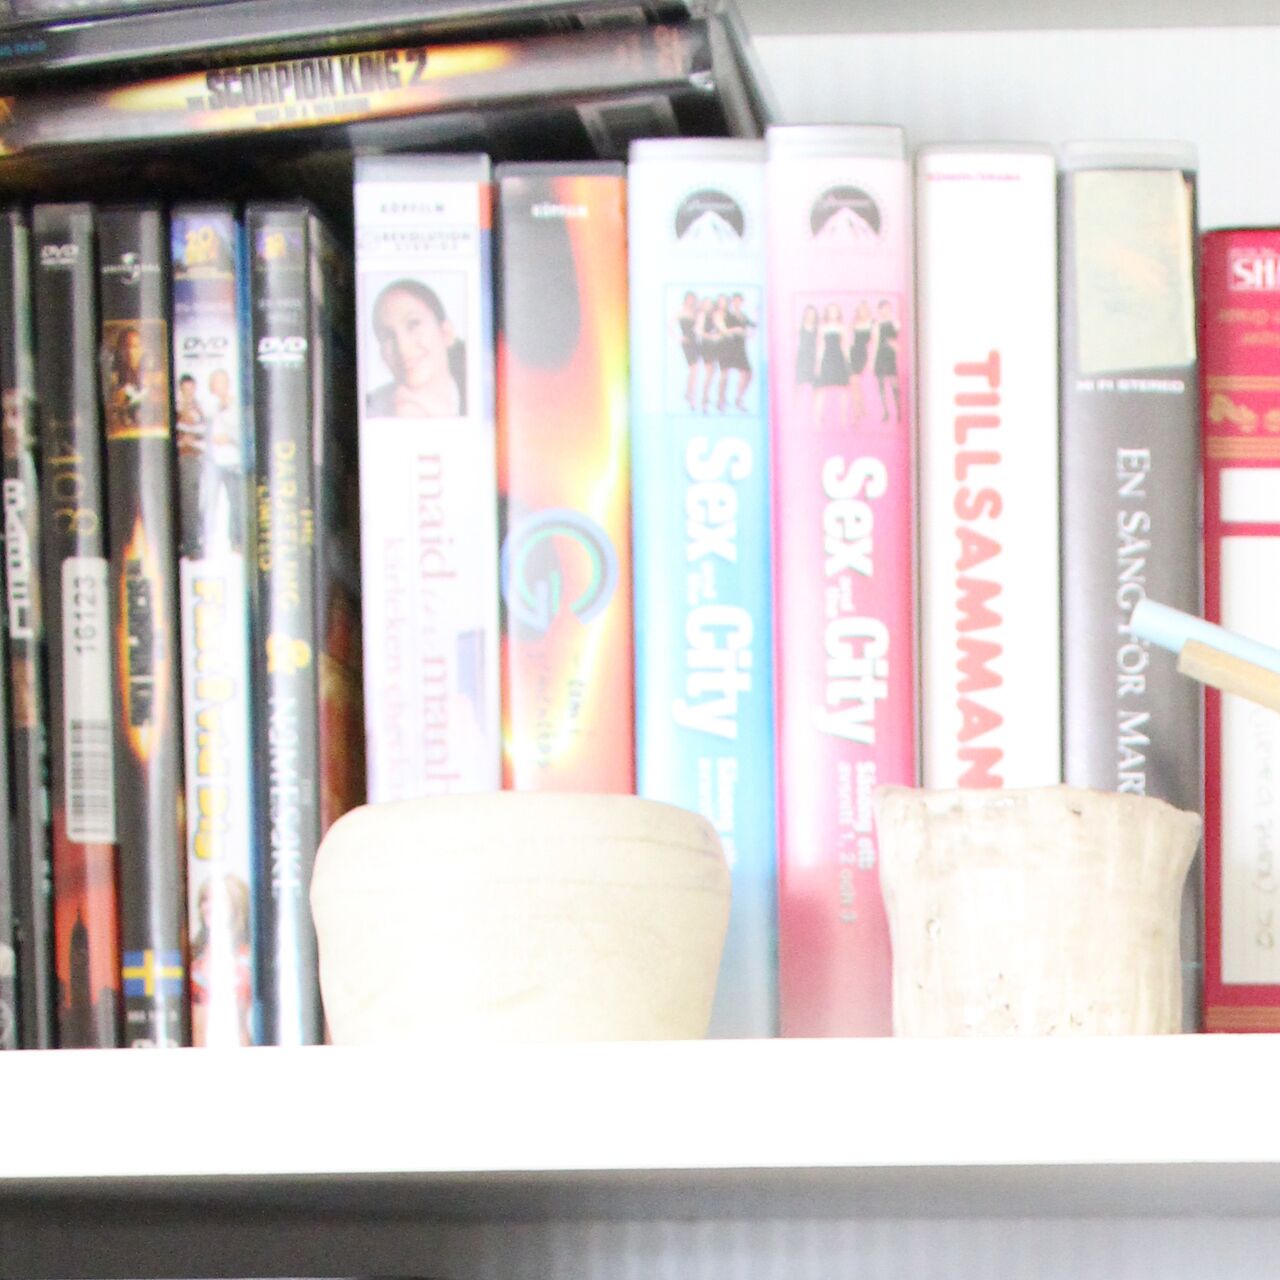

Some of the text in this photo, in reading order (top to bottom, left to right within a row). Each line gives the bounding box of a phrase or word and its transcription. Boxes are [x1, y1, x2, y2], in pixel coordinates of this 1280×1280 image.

[685, 435, 753, 563] Sex
[1116, 447, 1151, 499] EN
[816, 455, 891, 744] Sex City
[421, 655, 462, 790] manh
[673, 604, 754, 740] City
[1116, 710, 1151, 798] MAR
